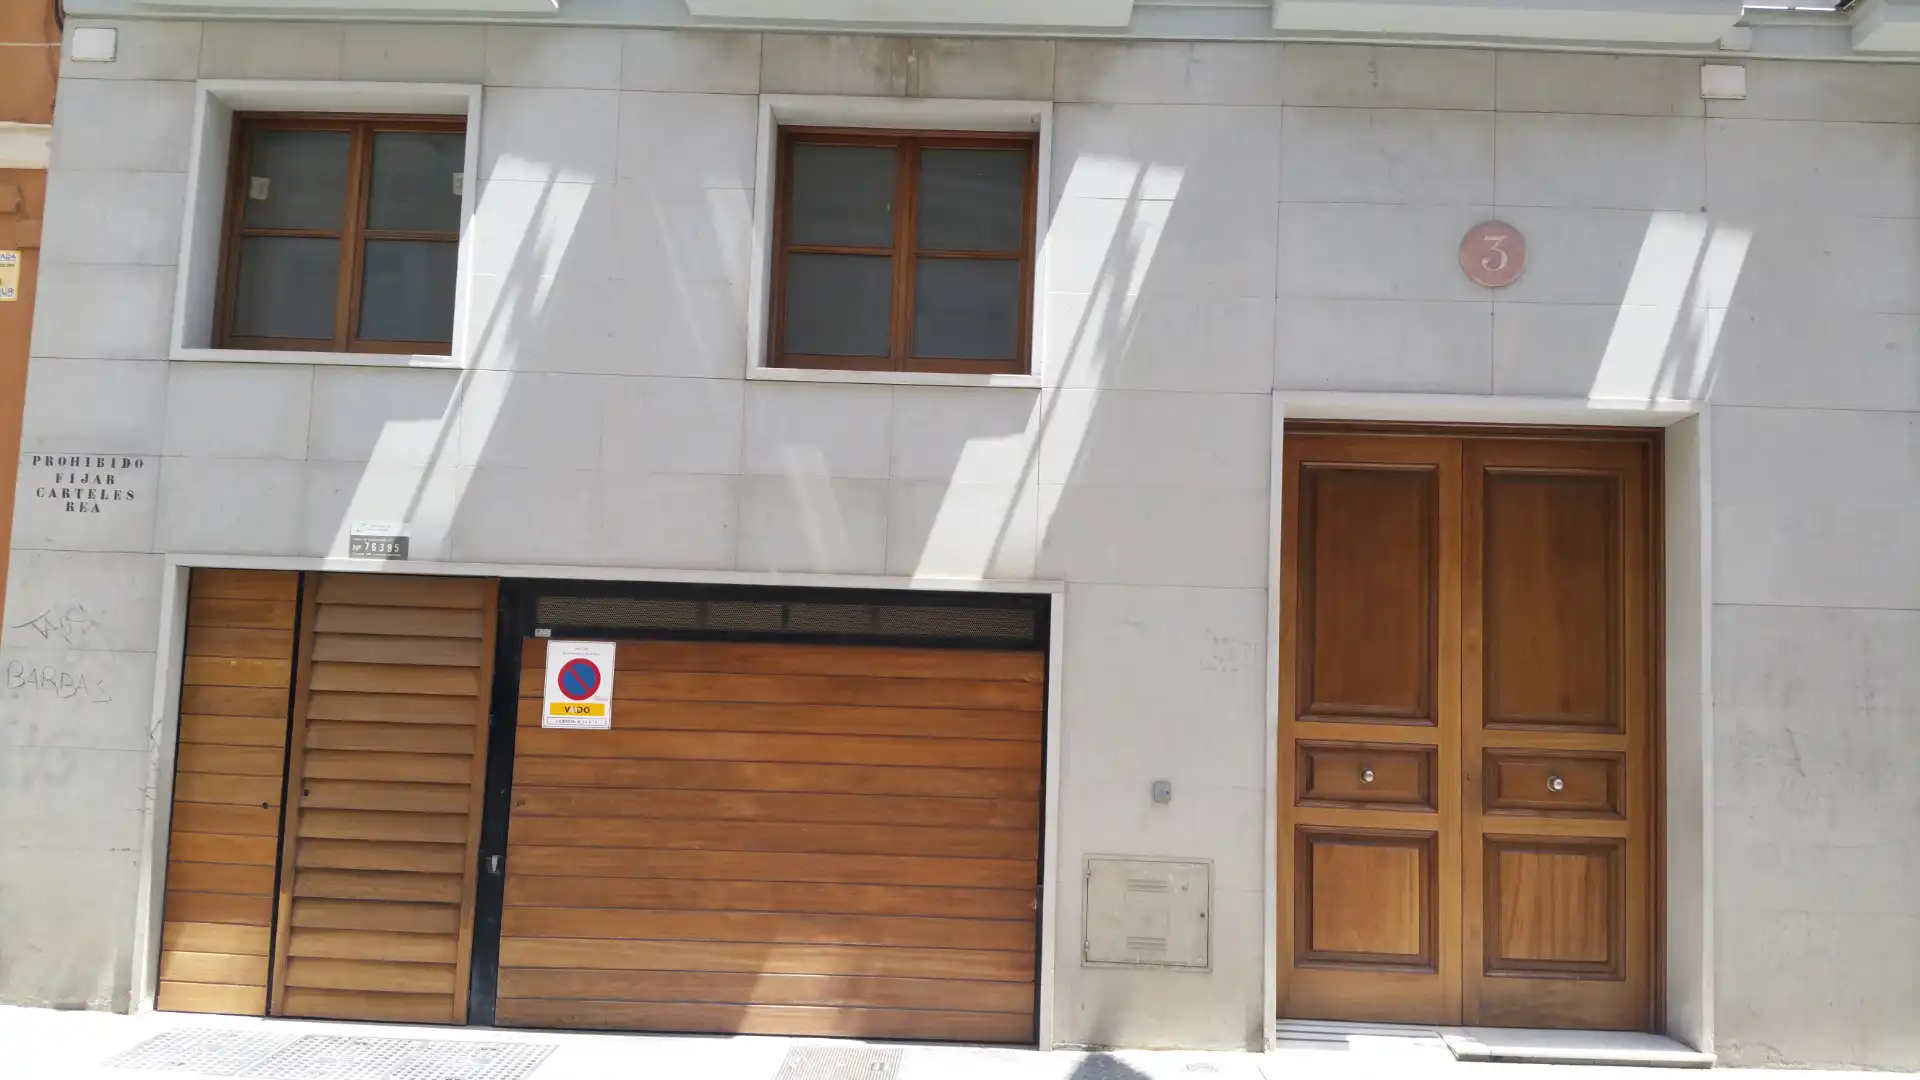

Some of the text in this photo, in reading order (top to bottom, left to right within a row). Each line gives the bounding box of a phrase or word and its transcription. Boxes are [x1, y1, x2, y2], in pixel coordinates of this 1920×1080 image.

[1481, 235, 1508, 271] 3
[32, 455, 144, 469] PROHIBIDO
[55, 472, 115, 485] FIJAR
[36, 487, 135, 501] CARTELES
[65, 501, 100, 513] REA
[364, 541, 400, 553] 76395
